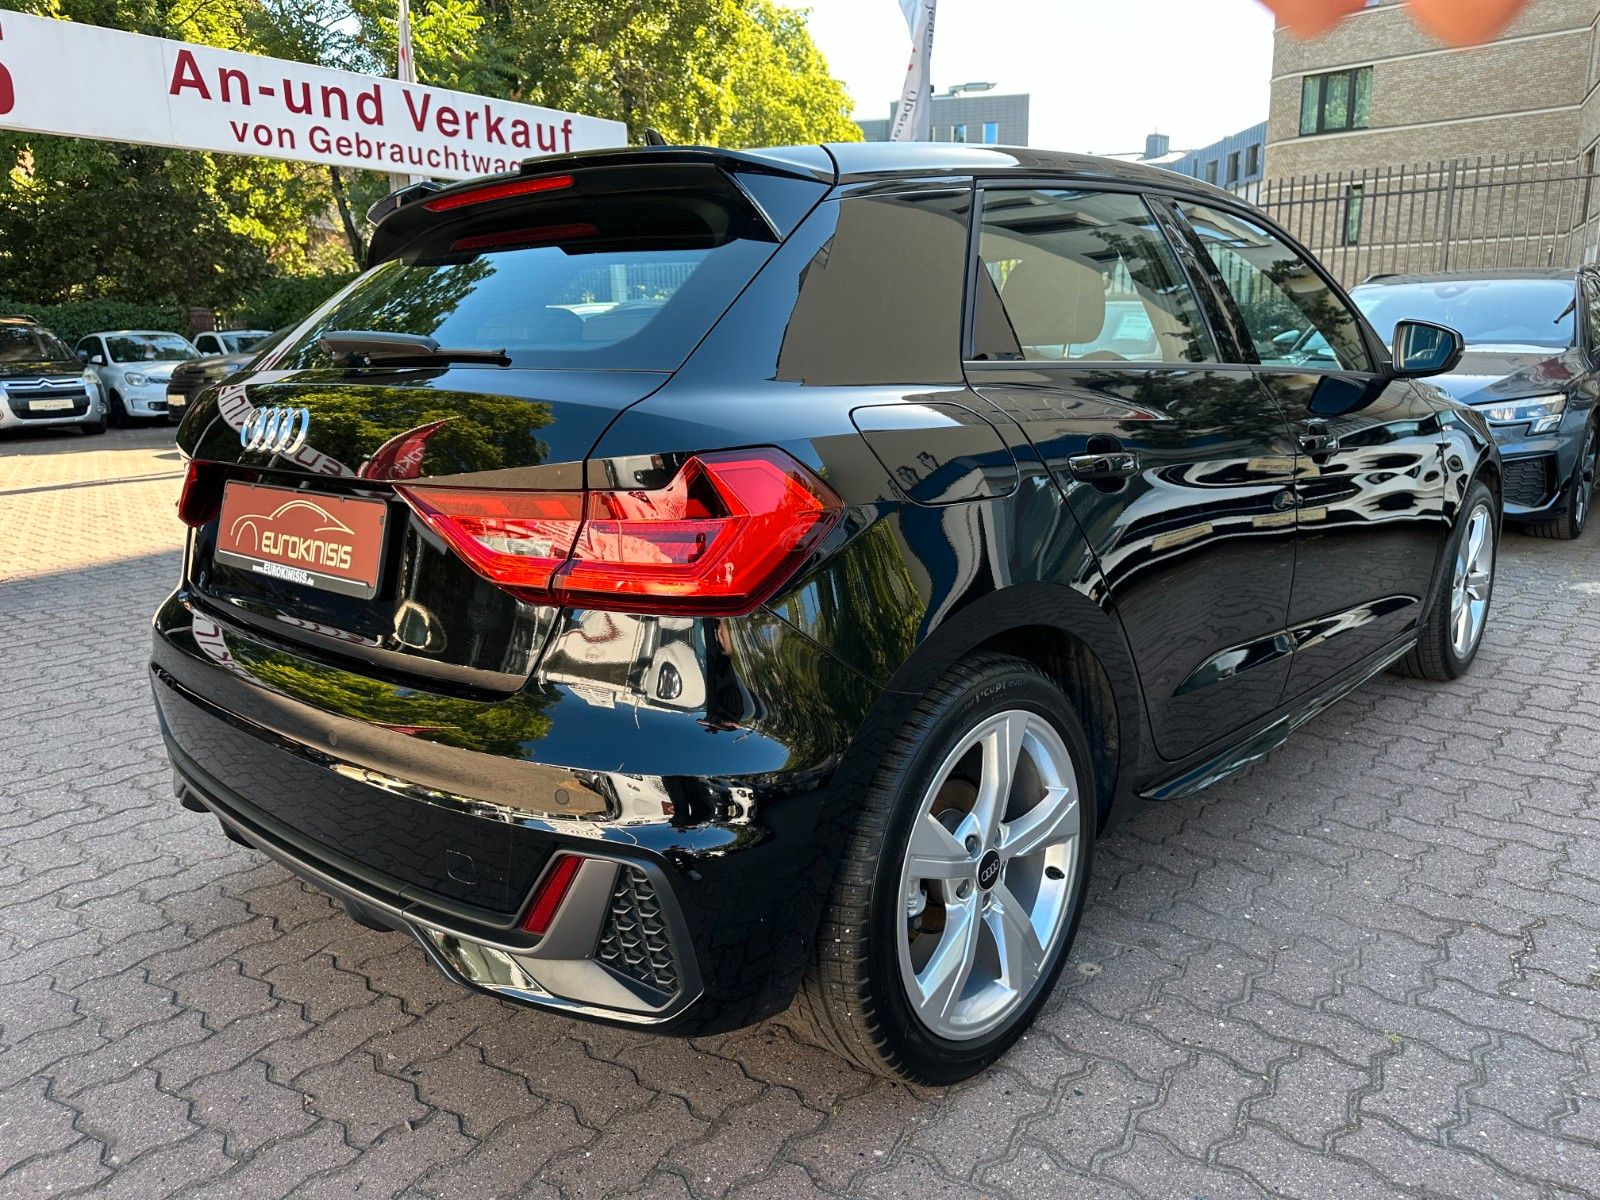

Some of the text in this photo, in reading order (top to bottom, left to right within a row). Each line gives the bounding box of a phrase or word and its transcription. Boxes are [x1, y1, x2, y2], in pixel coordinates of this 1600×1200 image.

[169, 49, 572, 152] An-und Verkauf
[229, 120, 296, 149] von
[261, 531, 353, 570] EUROKINISIS
